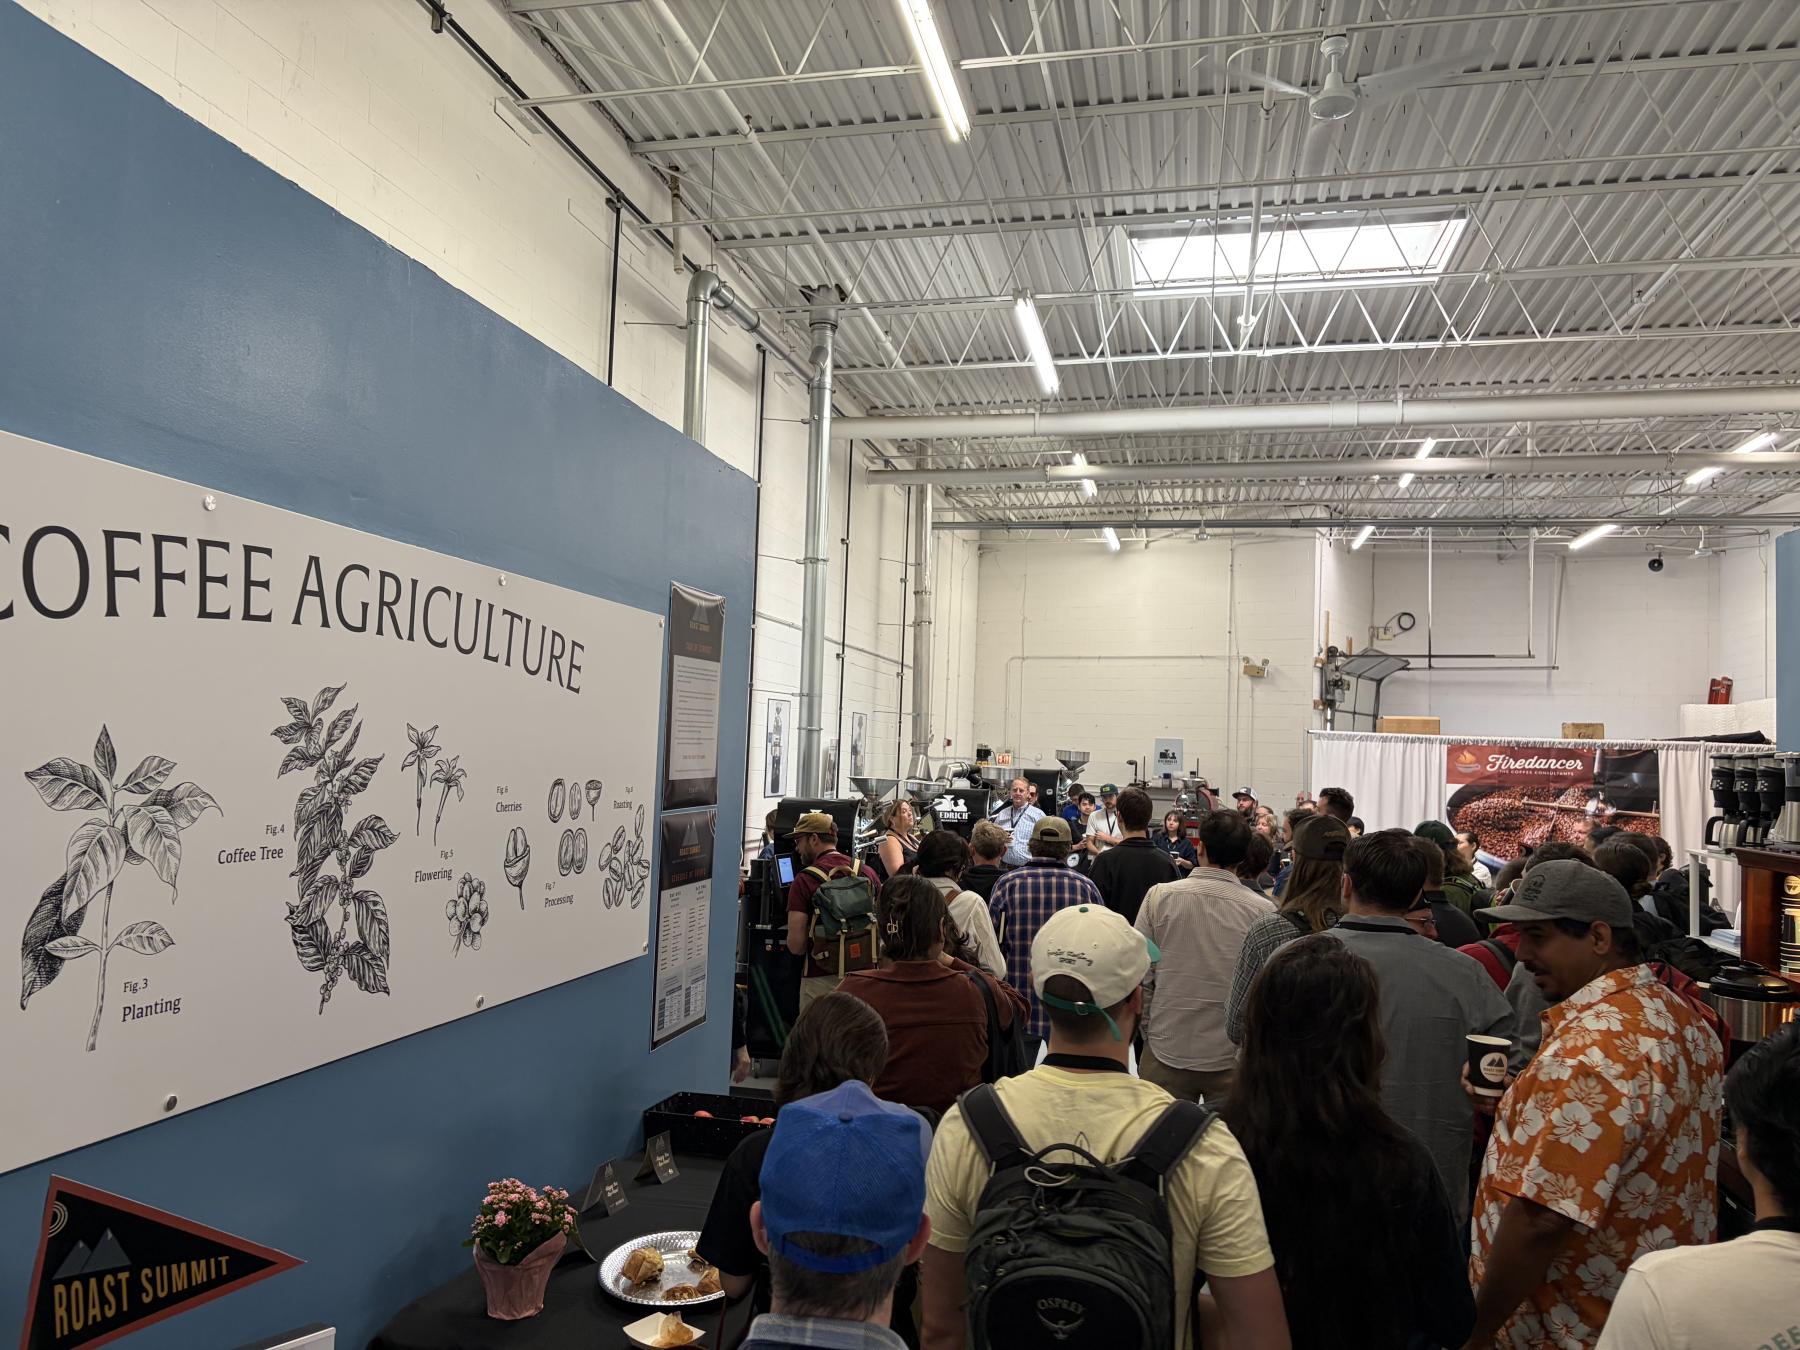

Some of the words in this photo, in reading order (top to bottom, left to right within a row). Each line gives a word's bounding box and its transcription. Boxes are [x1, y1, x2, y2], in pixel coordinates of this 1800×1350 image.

[291, 555, 585, 694] AGRICULTURE
[1486, 754, 1583, 771] Firedancer
[496, 802, 522, 813] Cherries
[613, 800, 632, 810] Roasting
[218, 848, 256, 864] Coffee
[260, 846, 284, 860] Tree
[414, 868, 453, 883] Flowering
[544, 894, 574, 908] Processing
[121, 998, 181, 1022] Planting
[54, 1271, 130, 1339] ROAST
[141, 1256, 230, 1303] SUMMIT
